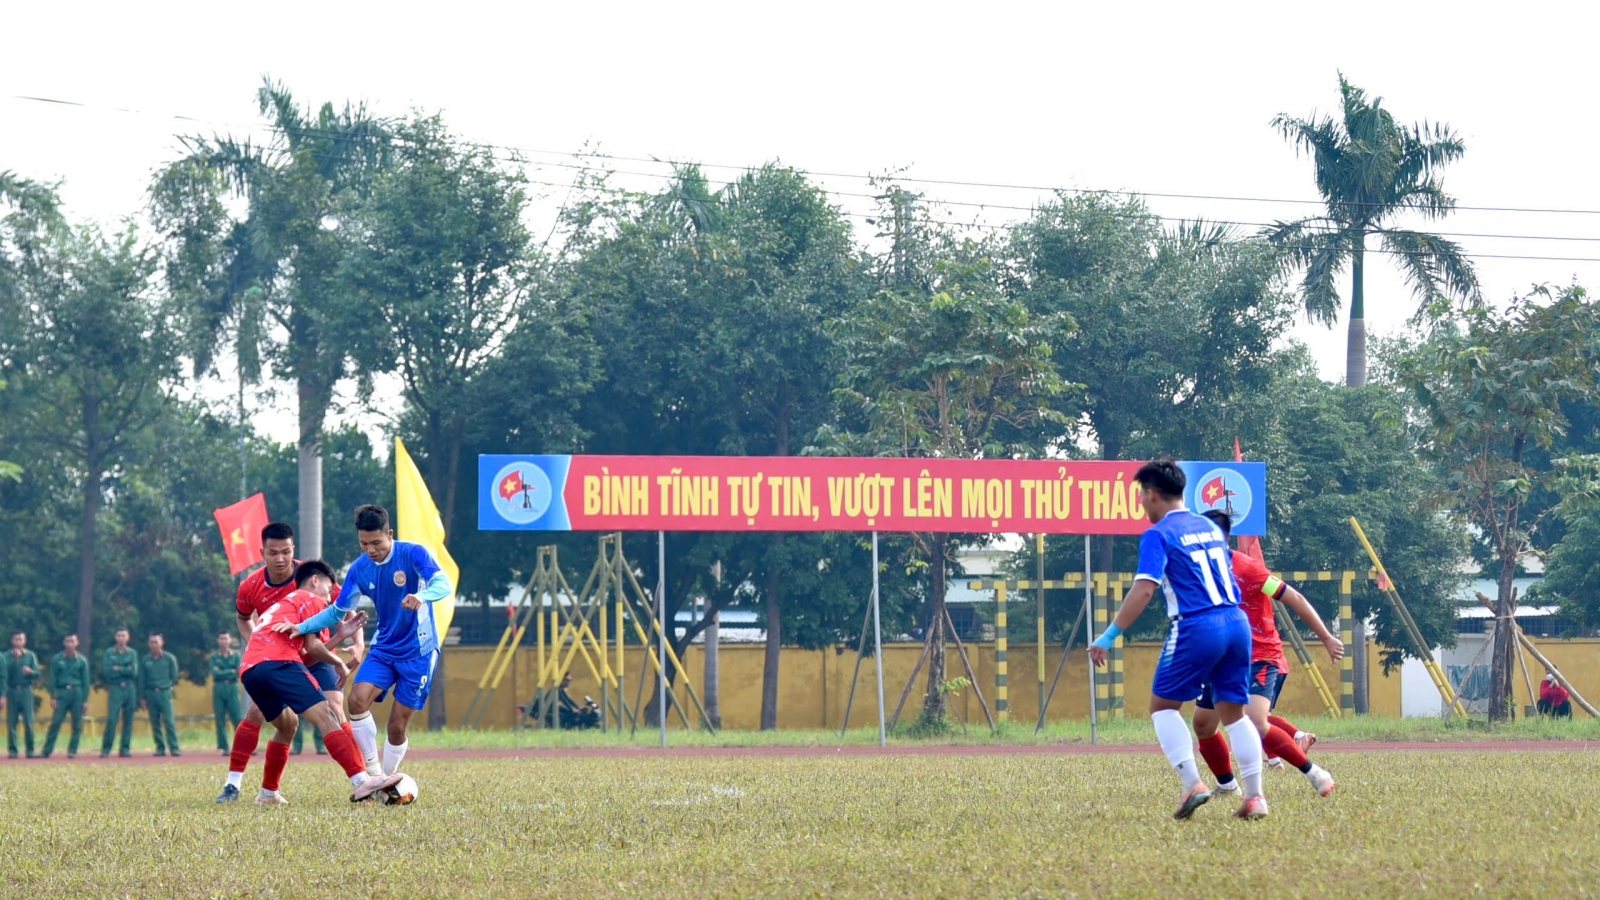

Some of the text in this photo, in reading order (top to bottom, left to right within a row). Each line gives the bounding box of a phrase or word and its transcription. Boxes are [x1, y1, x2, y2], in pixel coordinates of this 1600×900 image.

[583, 466, 1149, 528] BÌNH TĨNH TỰ TIN, VƯỢT LÊN MỌI THỬ THÁC
[1190, 547, 1237, 606] 11
